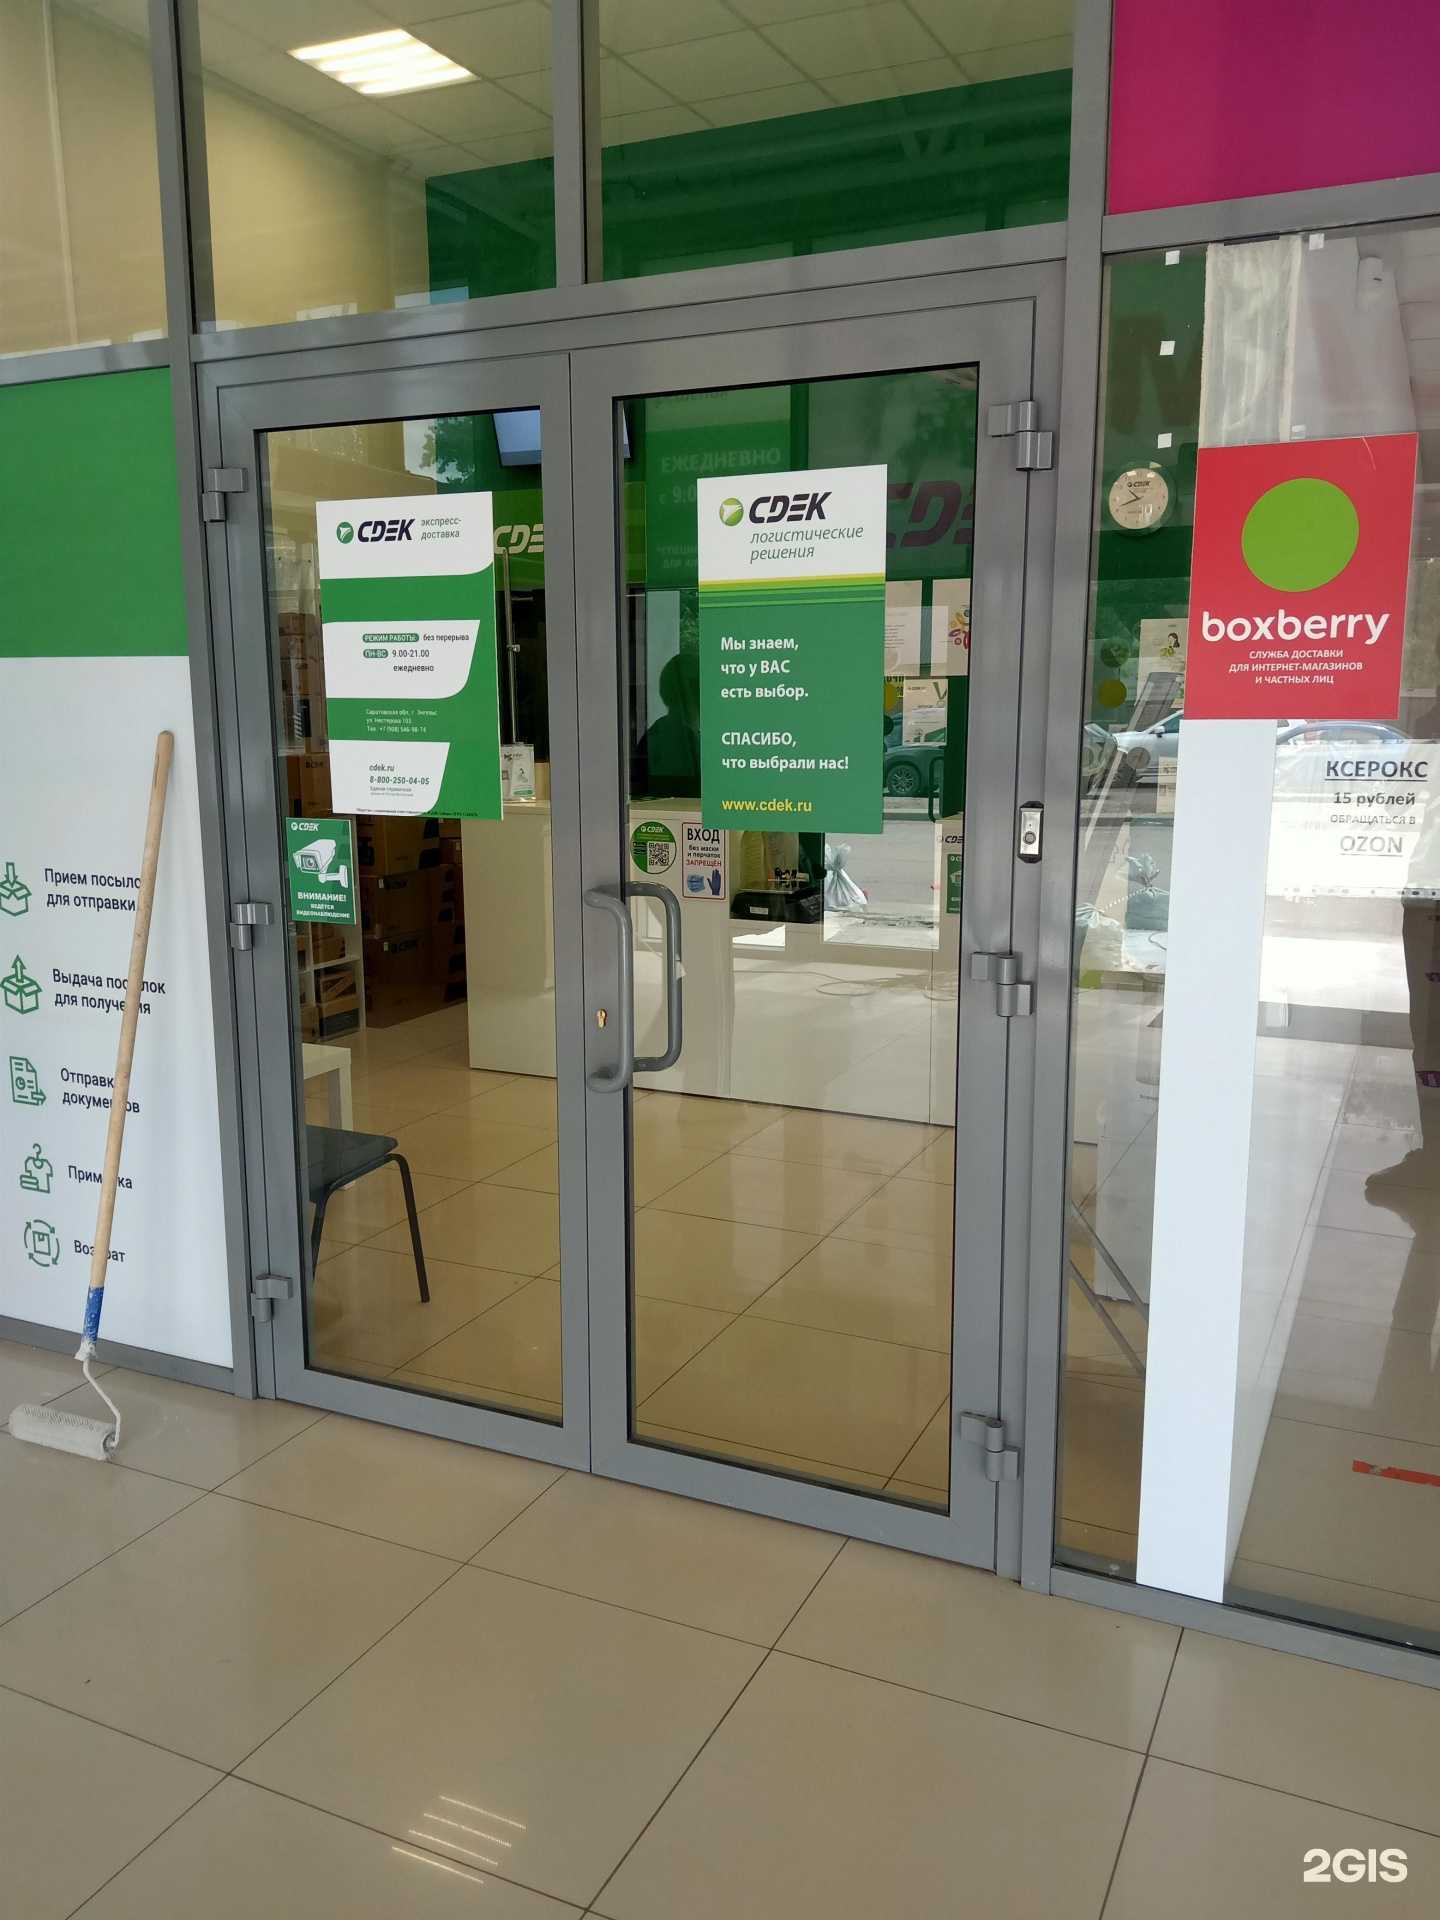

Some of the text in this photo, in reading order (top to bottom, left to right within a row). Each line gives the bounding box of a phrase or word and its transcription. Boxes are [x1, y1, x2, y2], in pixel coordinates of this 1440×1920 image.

[749, 491, 832, 523] CDEK
[357, 519, 415, 543] CDEK
[421, 518, 462, 528] экспресс-
[421, 531, 460, 541] доставка
[750, 526, 863, 545] логистические
[750, 545, 815, 564] решения
[1201, 609, 1390, 645] boxberry
[721, 637, 799, 650] Мы знаем,
[1249, 649, 1344, 660] СЛУЖБА ДОСТАВКИ
[721, 660, 790, 677] что у ВАС
[1229, 662, 1363, 673] ДЛЯ ИНТЕРНЕТ-МАГАЗИНОВ
[1265, 676, 1310, 684] ЧАСТНЫХ
[1312, 675, 1334, 684] ЛИЦ
[721, 685, 808, 700] есть выбор.
[721, 732, 797, 747] СПАСИБО,
[369, 764, 395, 772] cdek.ru
[722, 756, 849, 772] что выбрали нас!
[1326, 760, 1428, 778] КСЕРОКС
[369, 776, 430, 784] 8-800-250-04-05
[721, 799, 812, 812] www.cdek.ru
[1333, 792, 1415, 807] 15 рублей
[1330, 814, 1416, 825] ОБРАЩАТЬСЯ В
[687, 828, 720, 844] ВХОД
[1340, 836, 1403, 853] OZON
[44, 868, 142, 888] Прием посыло
[47, 893, 136, 912] для отправки
[297, 892, 346, 902] ВНИМАНИЕ!
[52, 968, 166, 994] Выдача послок
[54, 993, 151, 1014] для получеия
[60, 1068, 114, 1088] Отправк
[62, 1092, 140, 1113] докумеов
[68, 1165, 133, 1189] Примка
